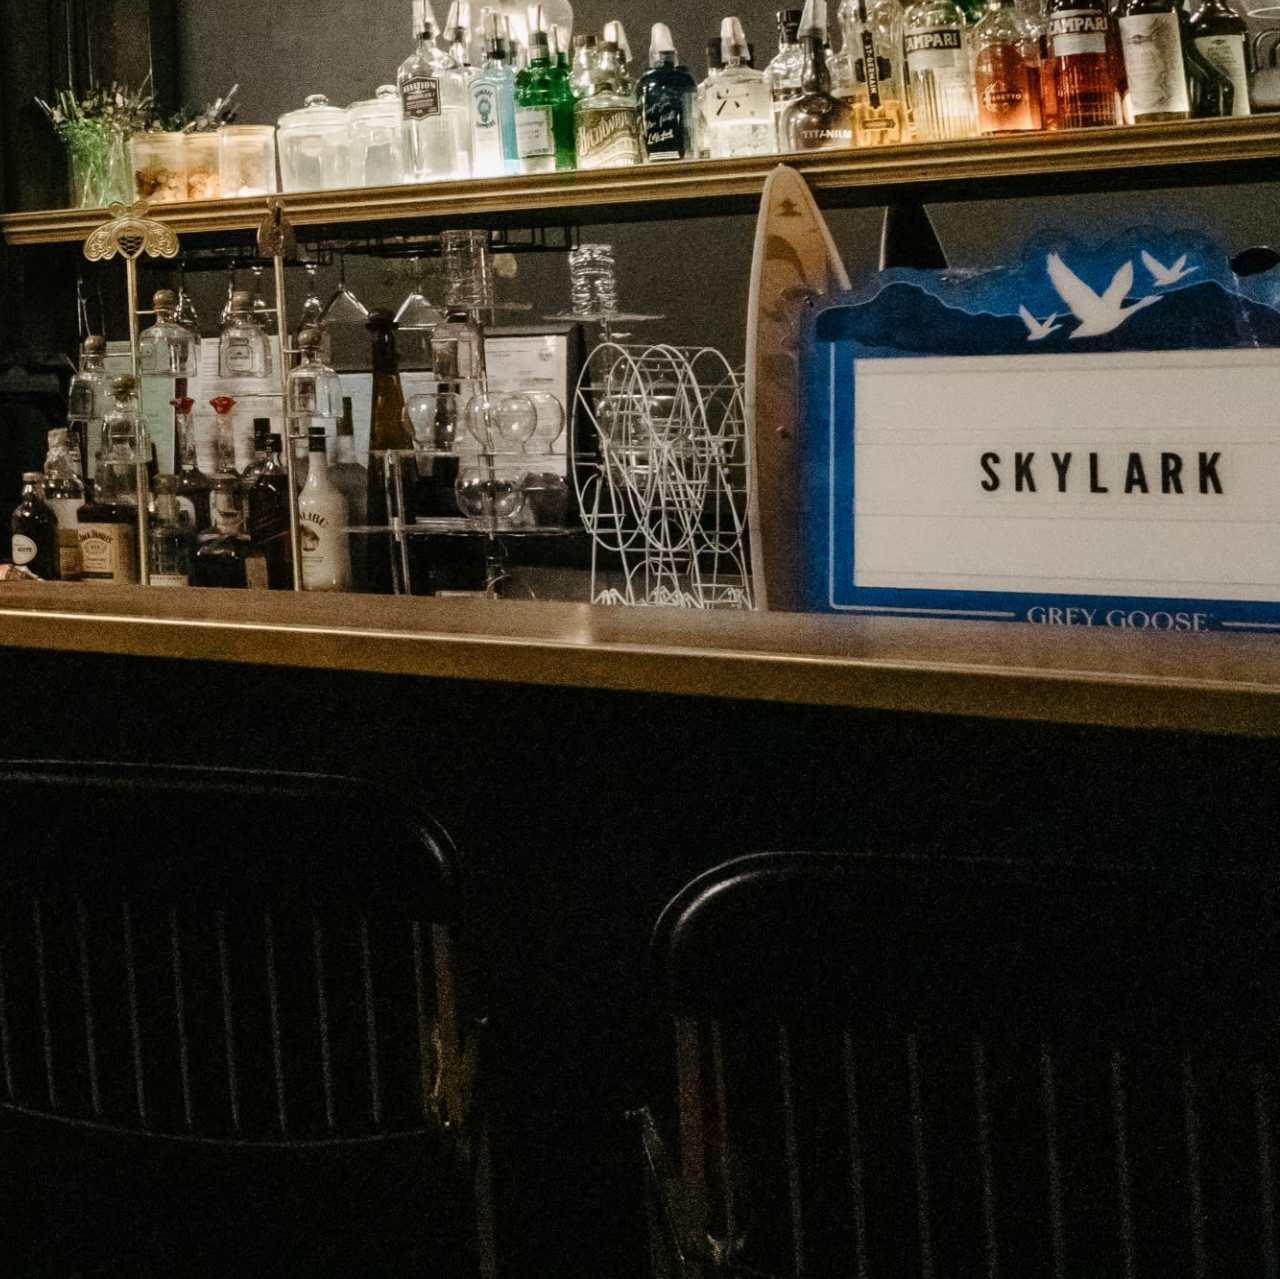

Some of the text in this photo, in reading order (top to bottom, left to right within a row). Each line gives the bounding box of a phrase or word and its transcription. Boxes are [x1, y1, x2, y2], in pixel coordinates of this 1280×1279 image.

[1048, 16, 1109, 34] CAMPARI
[905, 31, 959, 51] AMPARI
[979, 451, 1224, 494] SKYLARK
[1026, 606, 1210, 632] GREY GOOSE
